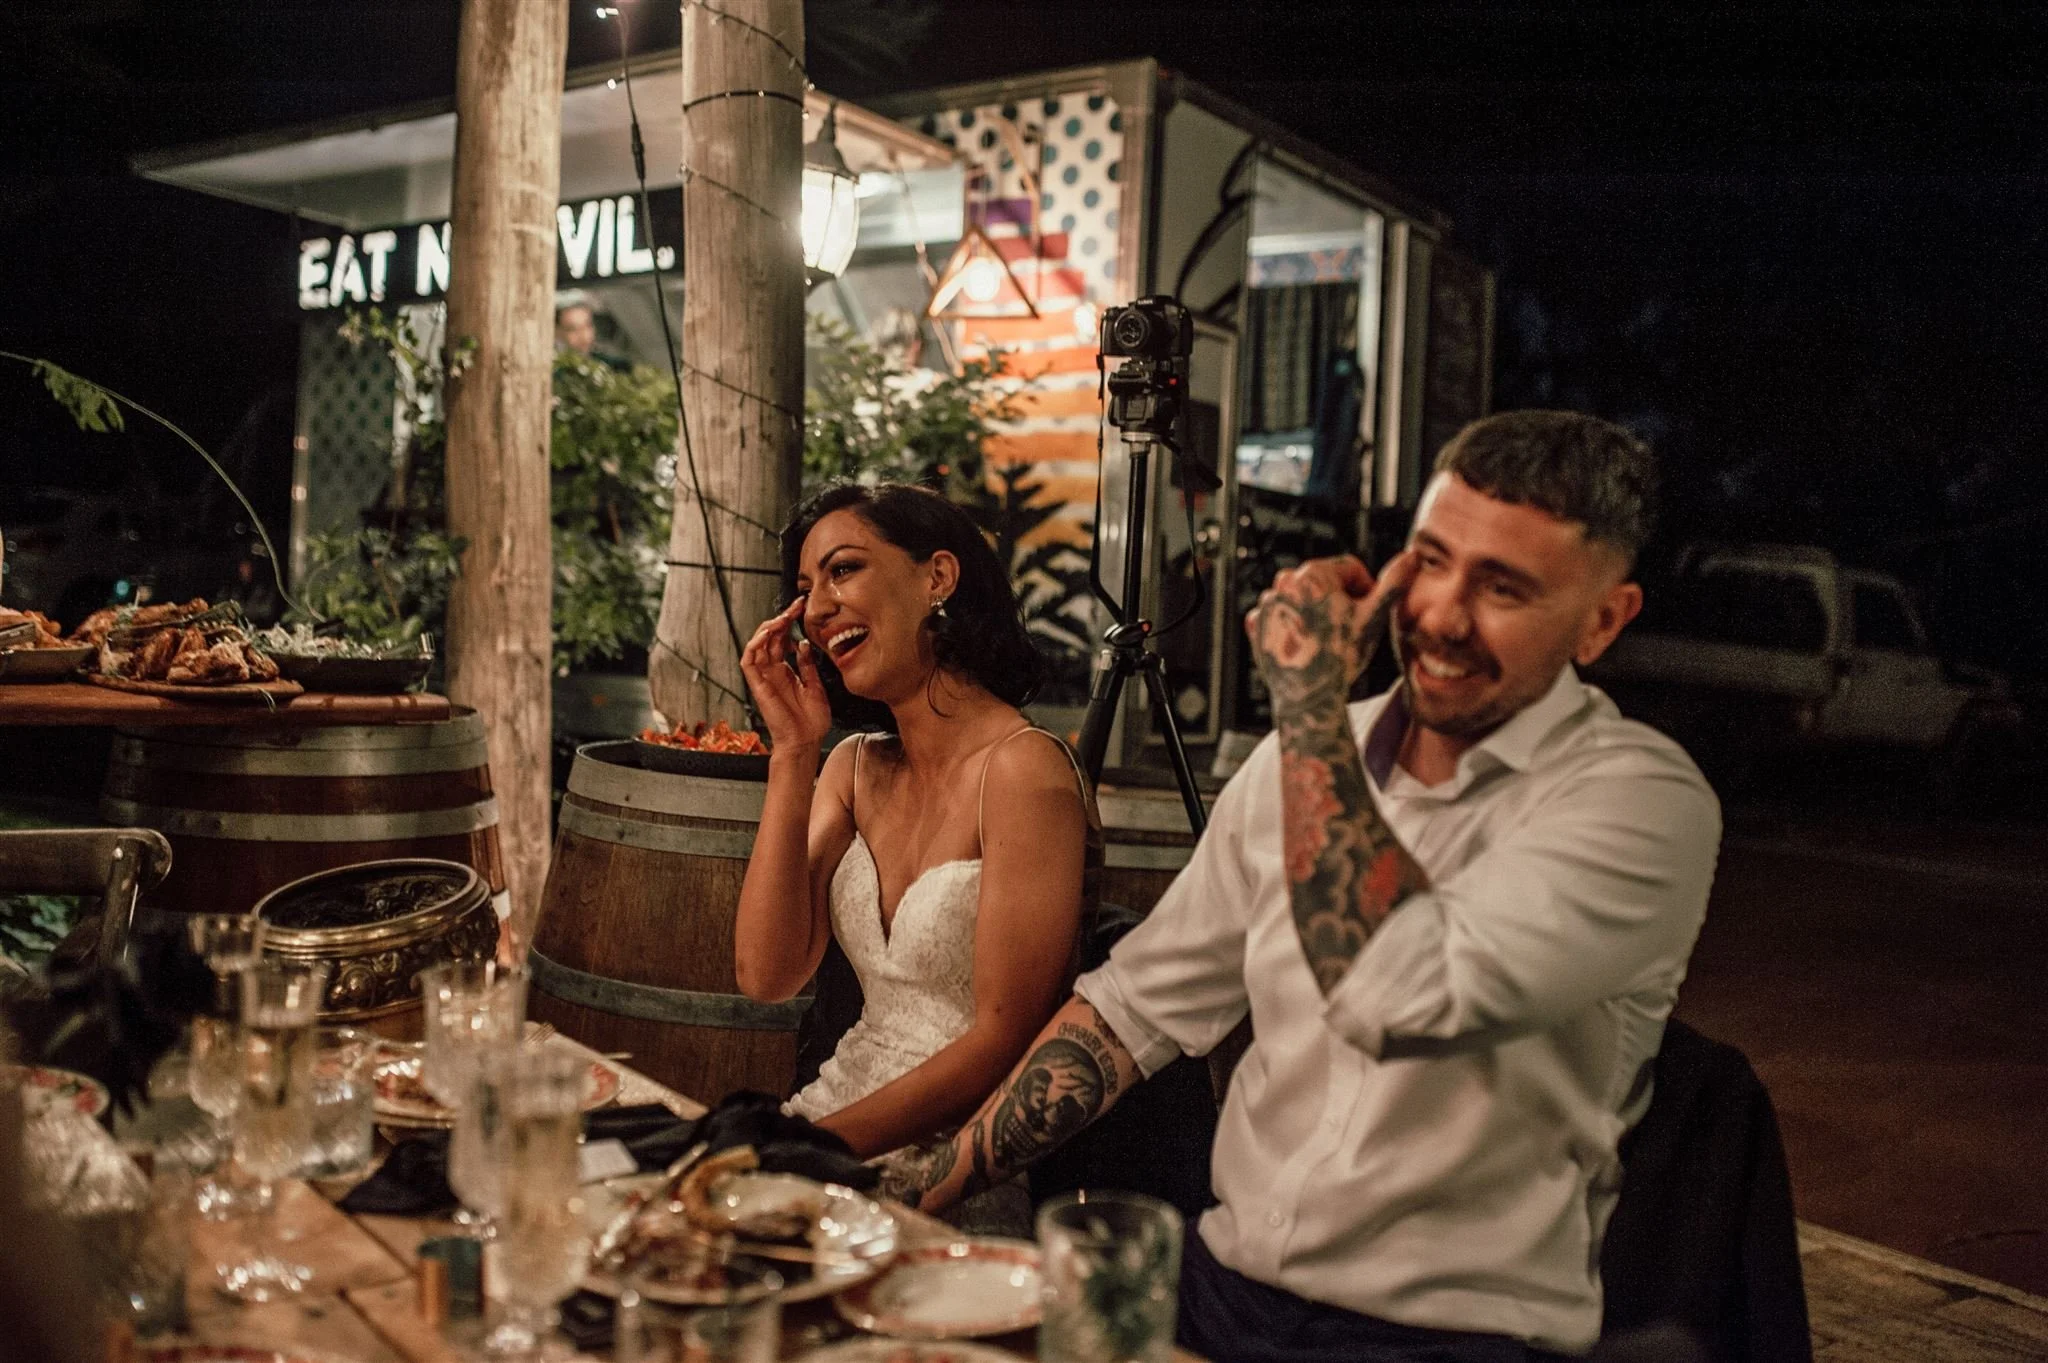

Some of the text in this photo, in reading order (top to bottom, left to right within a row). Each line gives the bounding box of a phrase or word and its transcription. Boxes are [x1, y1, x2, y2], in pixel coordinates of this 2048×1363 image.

[299, 195, 675, 309] EAT N VIL.
